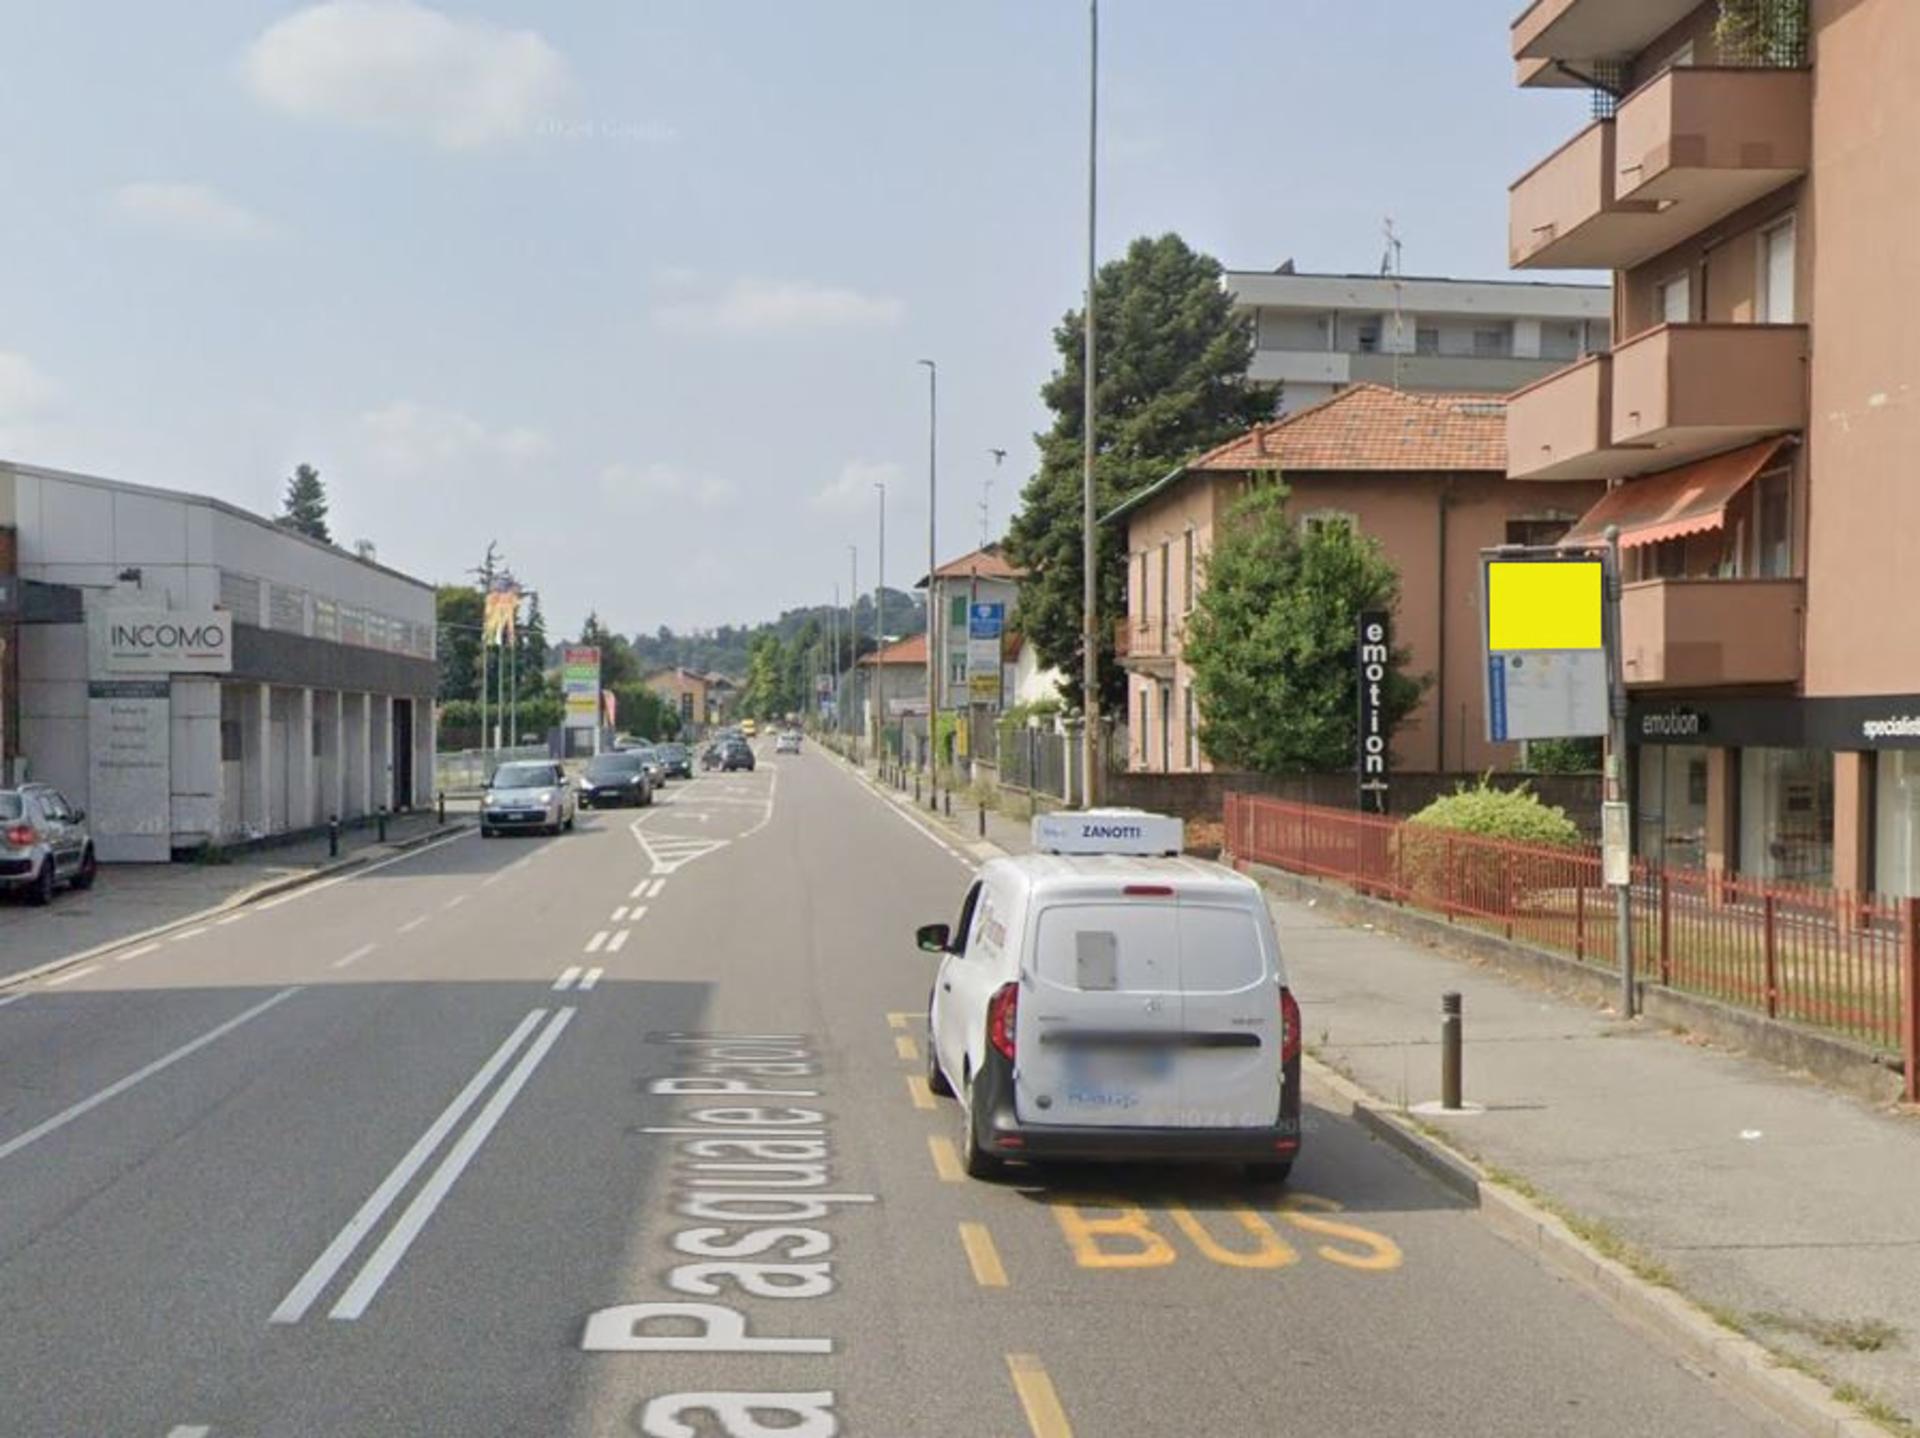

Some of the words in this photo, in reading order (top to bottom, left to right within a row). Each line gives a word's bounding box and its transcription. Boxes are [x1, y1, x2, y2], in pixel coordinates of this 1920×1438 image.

[111, 624, 223, 648] INCOMO
[1363, 623, 1387, 773] emotion
[1643, 709, 1698, 735] emotion
[1082, 824, 1141, 840] ZANOTTI
[651, 1032, 818, 1095] Paoli
[581, 1106, 877, 1352] Pasquale
[1049, 1193, 1403, 1269] BUS
